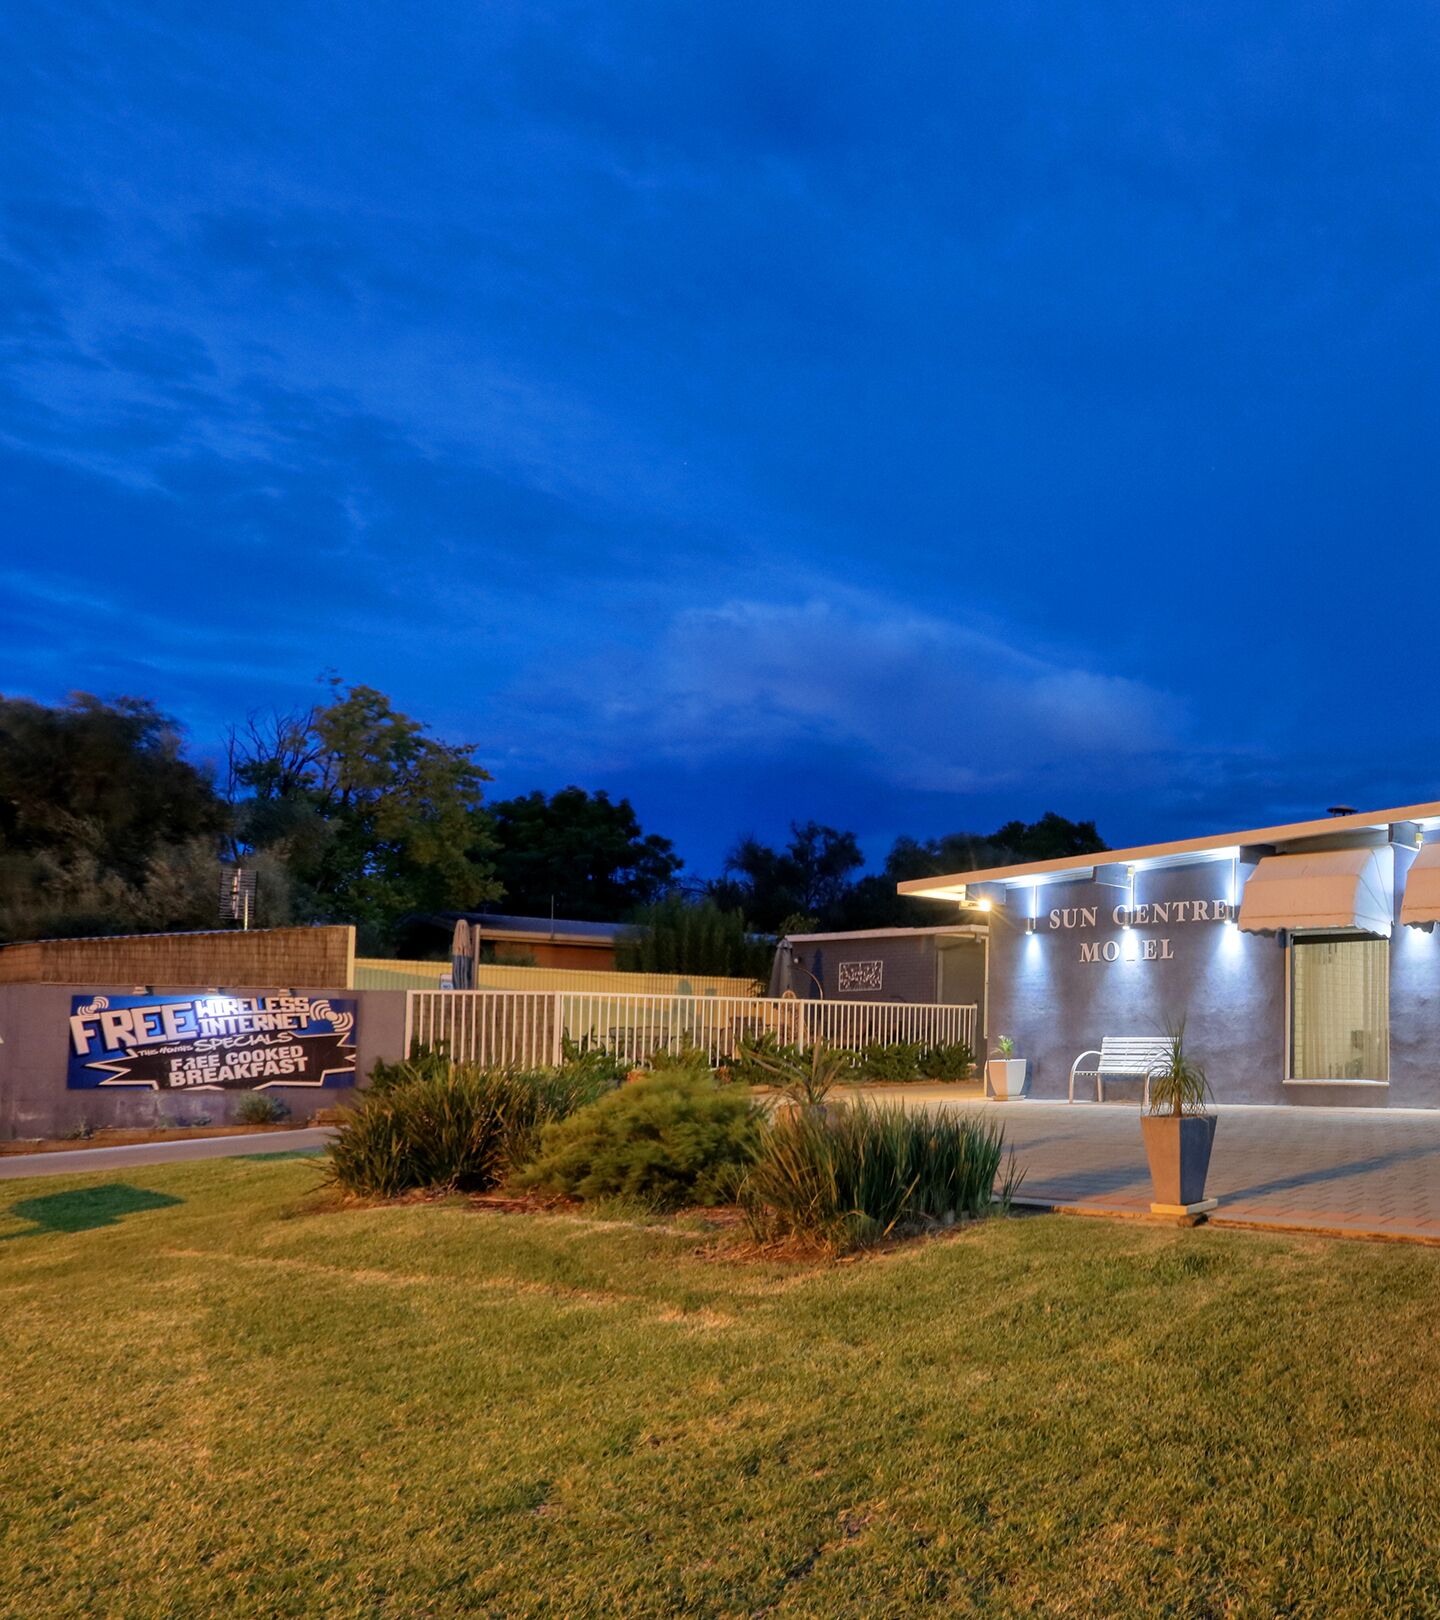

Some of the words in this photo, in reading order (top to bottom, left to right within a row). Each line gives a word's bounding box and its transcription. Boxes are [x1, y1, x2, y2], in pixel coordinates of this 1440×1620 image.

[1050, 906, 1098, 928] SUN
[1112, 900, 1227, 925] CENTRE
[1079, 939, 1174, 962] MOEL
[194, 997, 310, 1019] WIRELESS
[70, 1002, 198, 1055] FREE
[198, 1013, 310, 1037] INTERNET
[137, 1048, 159, 1057] THIS
[193, 1031, 293, 1052] SPECIALS
[168, 1056, 309, 1087] BREAKFAST
[170, 1054, 220, 1072] FREE
[225, 1046, 303, 1065] COOKED
